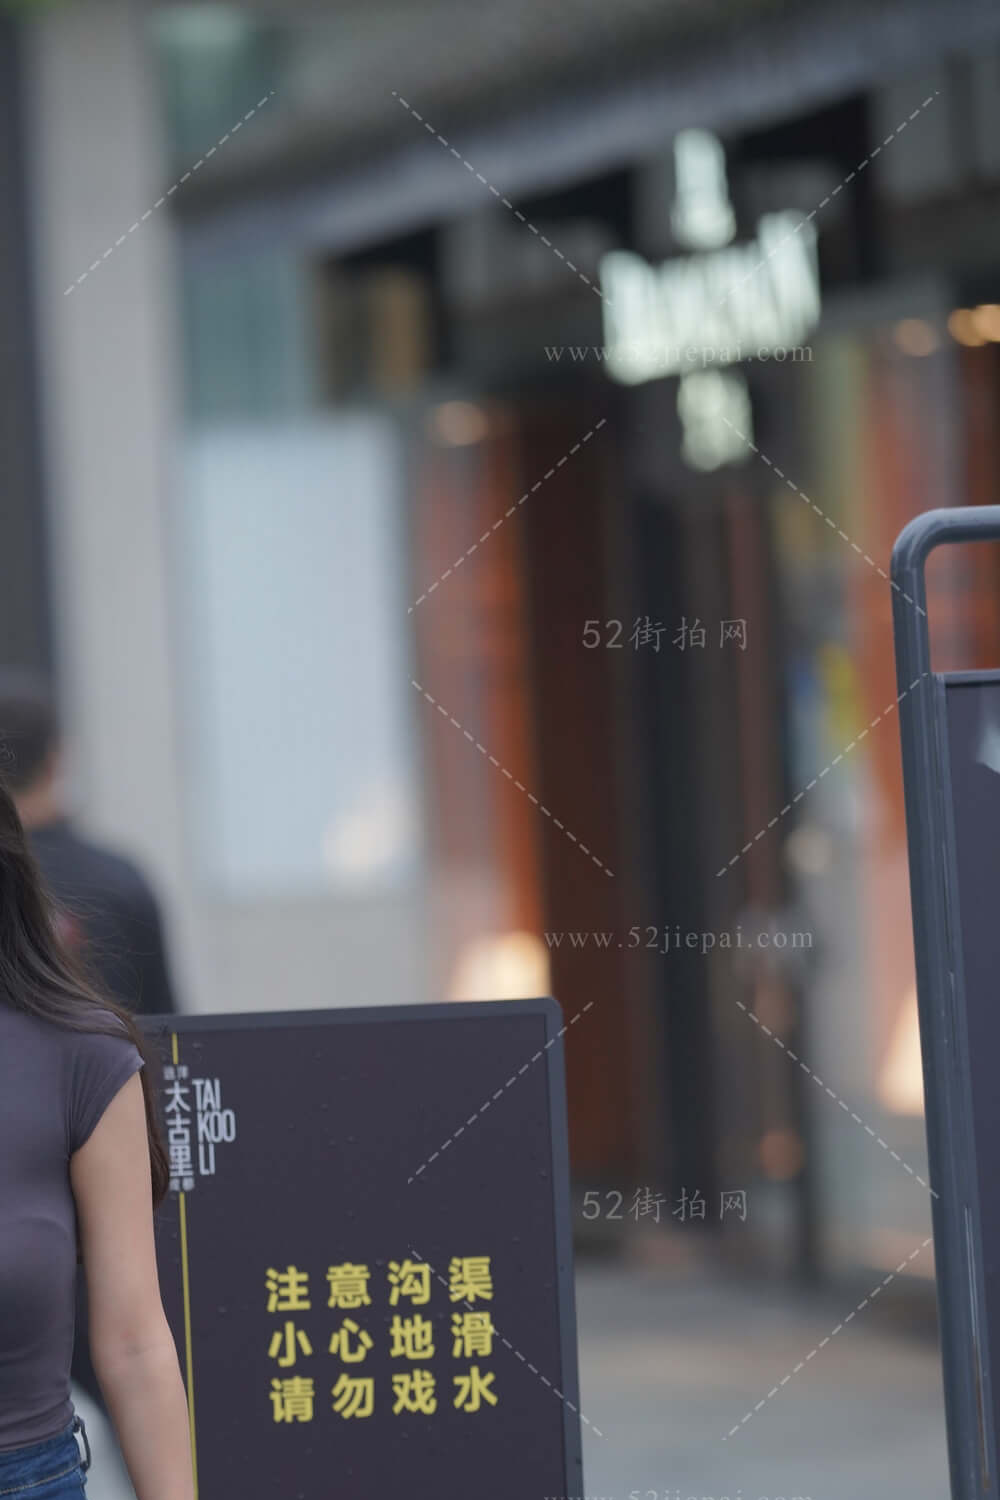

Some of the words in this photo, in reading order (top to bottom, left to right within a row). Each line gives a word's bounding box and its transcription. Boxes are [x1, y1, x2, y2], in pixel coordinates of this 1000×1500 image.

[192, 1078, 221, 1111] TAI
[197, 1110, 236, 1143] KOO
[199, 1143, 215, 1175] LI
[265, 1256, 494, 1313] 注意沟渠
[268, 1311, 496, 1367] 小心地滑
[269, 1365, 499, 1423] 请勿戏水
